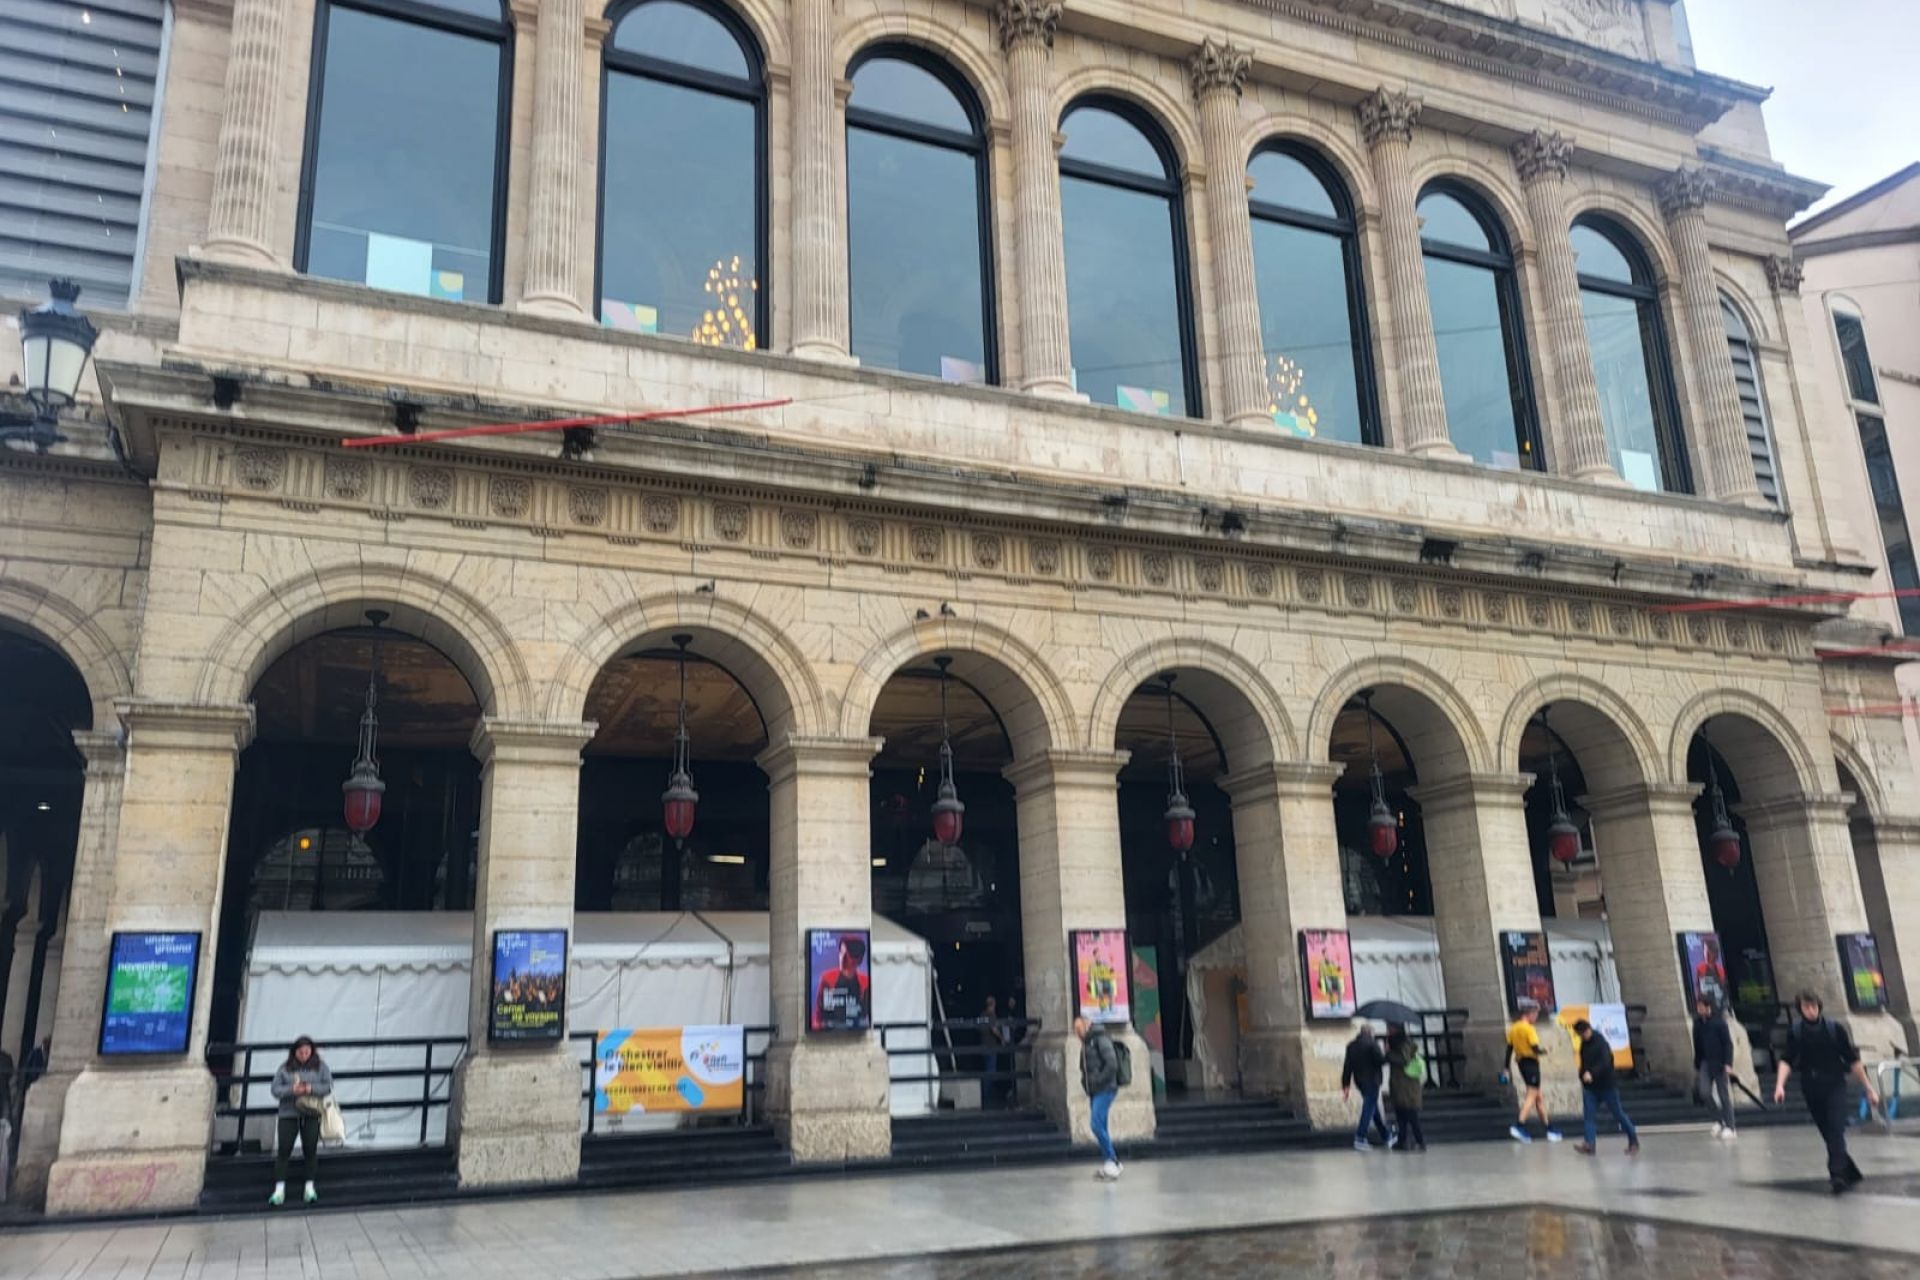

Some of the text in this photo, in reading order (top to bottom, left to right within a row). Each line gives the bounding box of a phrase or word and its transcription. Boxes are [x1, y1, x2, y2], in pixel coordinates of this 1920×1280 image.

[145, 935, 175, 945] under
[155, 944, 191, 954] ground
[118, 962, 168, 972] novembre
[606, 1049, 667, 1060] Orchestrer
[618, 1061, 642, 1071] bien
[647, 1059, 682, 1070] vieillir
